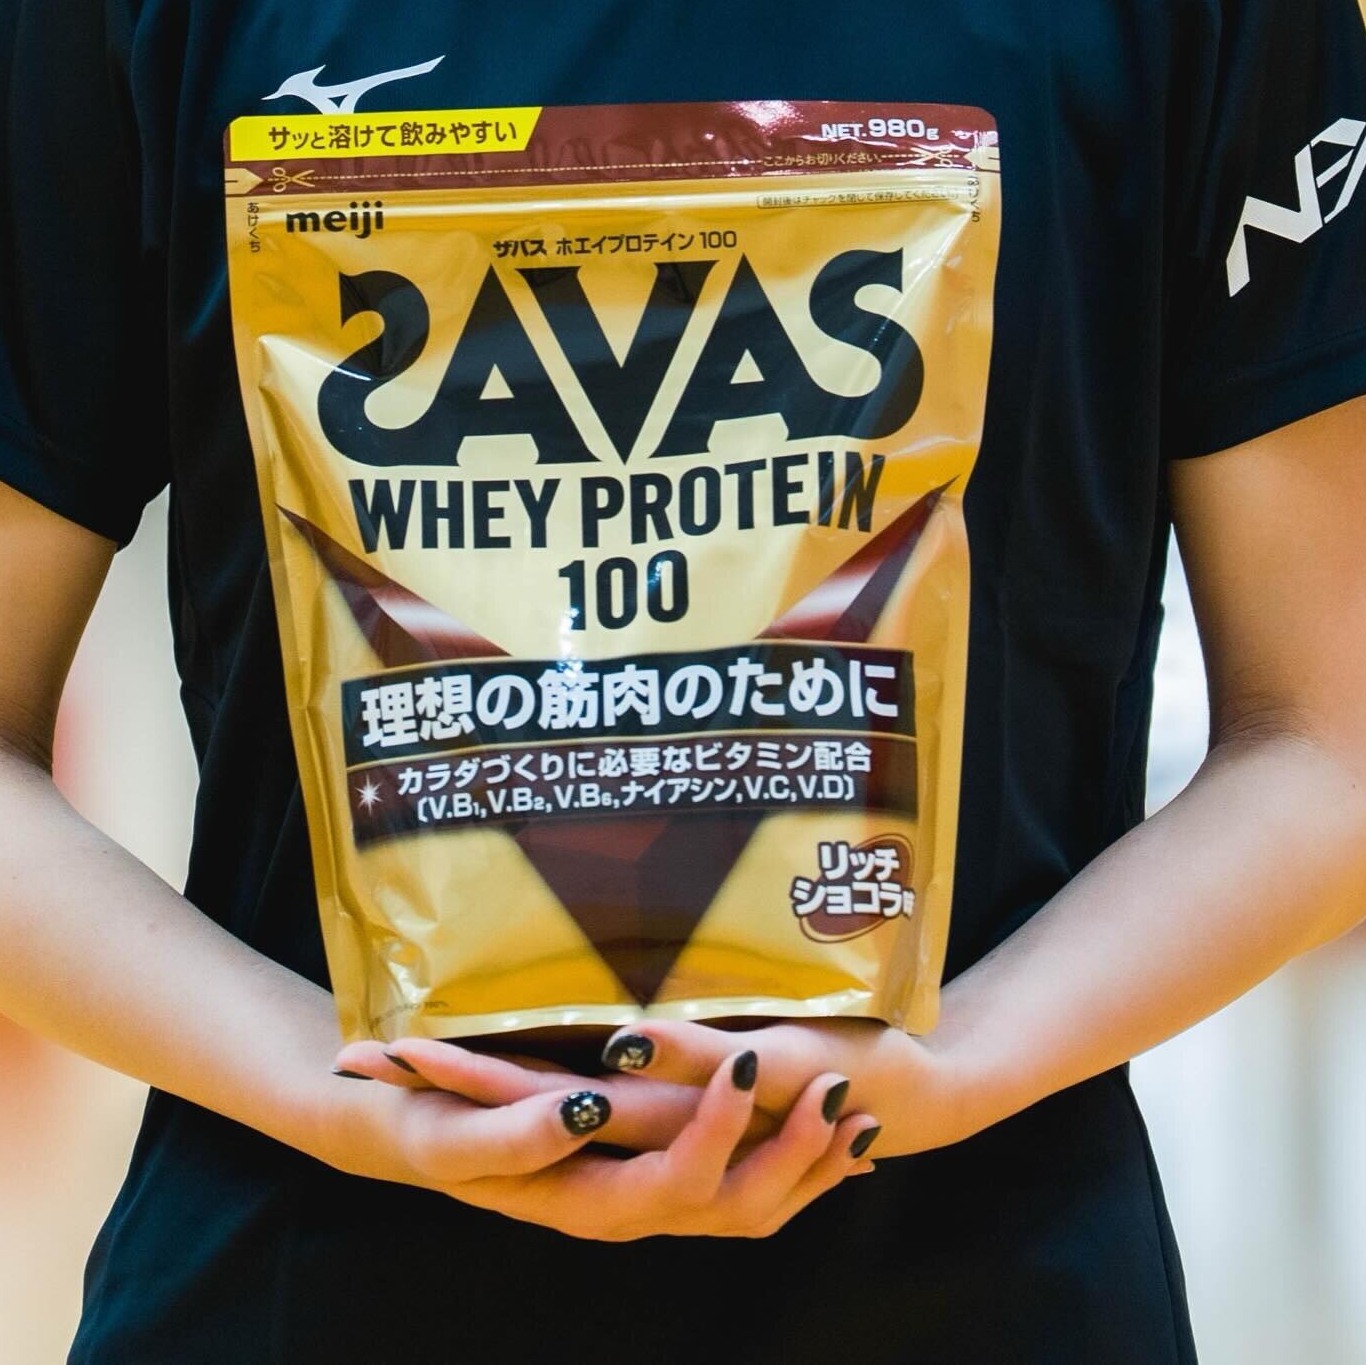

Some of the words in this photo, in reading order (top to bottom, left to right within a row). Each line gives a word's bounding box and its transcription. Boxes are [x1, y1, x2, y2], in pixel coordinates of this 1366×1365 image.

[267, 120, 518, 152] サッと溶けて飲みやすい
[246, 201, 261, 253] あけくち
[285, 200, 384, 239] meiji
[492, 238, 548, 258] ザバス
[317, 246, 925, 467] SAVAS
[348, 478, 562, 554] WHEY
[581, 451, 886, 549] PROTEIN
[558, 550, 689, 631] 100
[360, 655, 899, 749] 理想の筋肉のために
[397, 740, 872, 796] カラダづくりに必要なビタミン配合
[819, 842, 901, 881] リッチ
